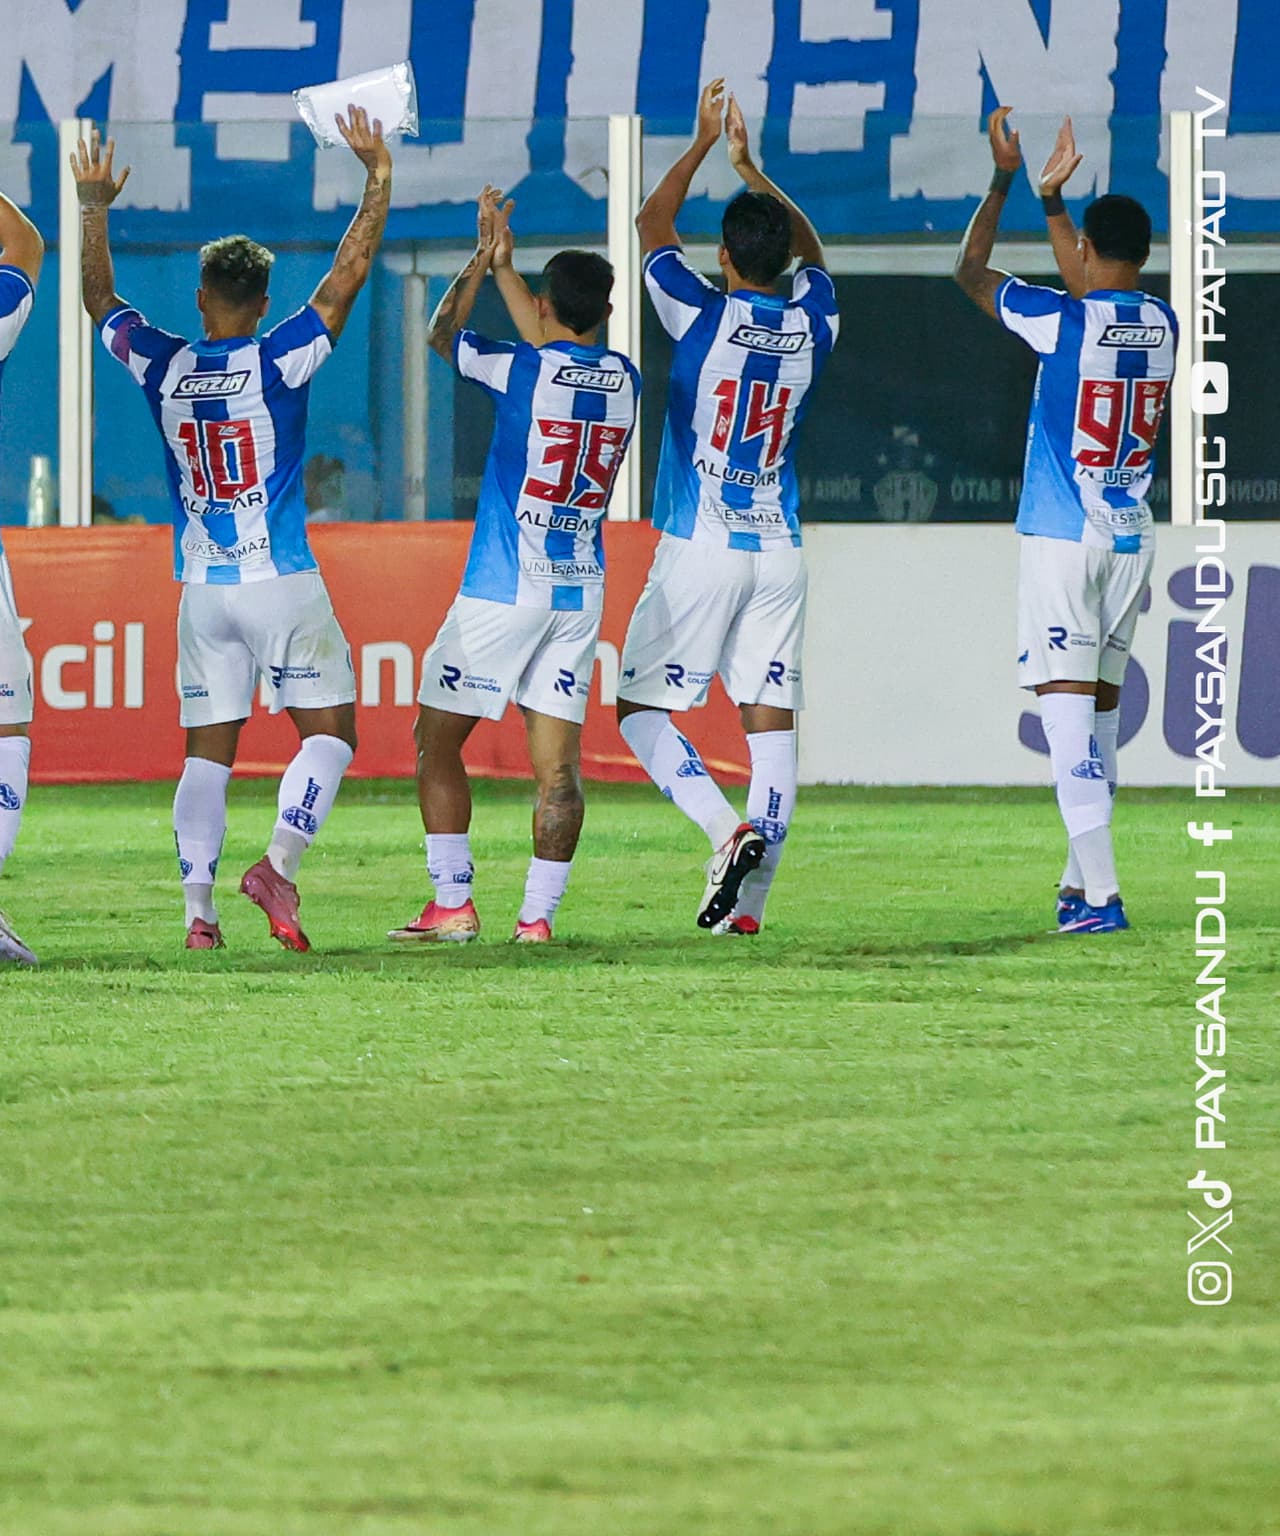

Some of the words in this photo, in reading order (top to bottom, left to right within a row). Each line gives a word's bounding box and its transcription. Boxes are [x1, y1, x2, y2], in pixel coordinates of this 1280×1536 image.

[740, 328, 805, 352] GAZIN
[1105, 326, 1165, 345] GAZIN
[178, 373, 248, 396] GAZIN
[559, 367, 624, 390] GAZIN
[709, 378, 793, 469] 14
[1073, 379, 1172, 469] 99
[177, 418, 260, 501] 10
[523, 418, 628, 510] 39
[694, 458, 777, 487] ALUBAR
